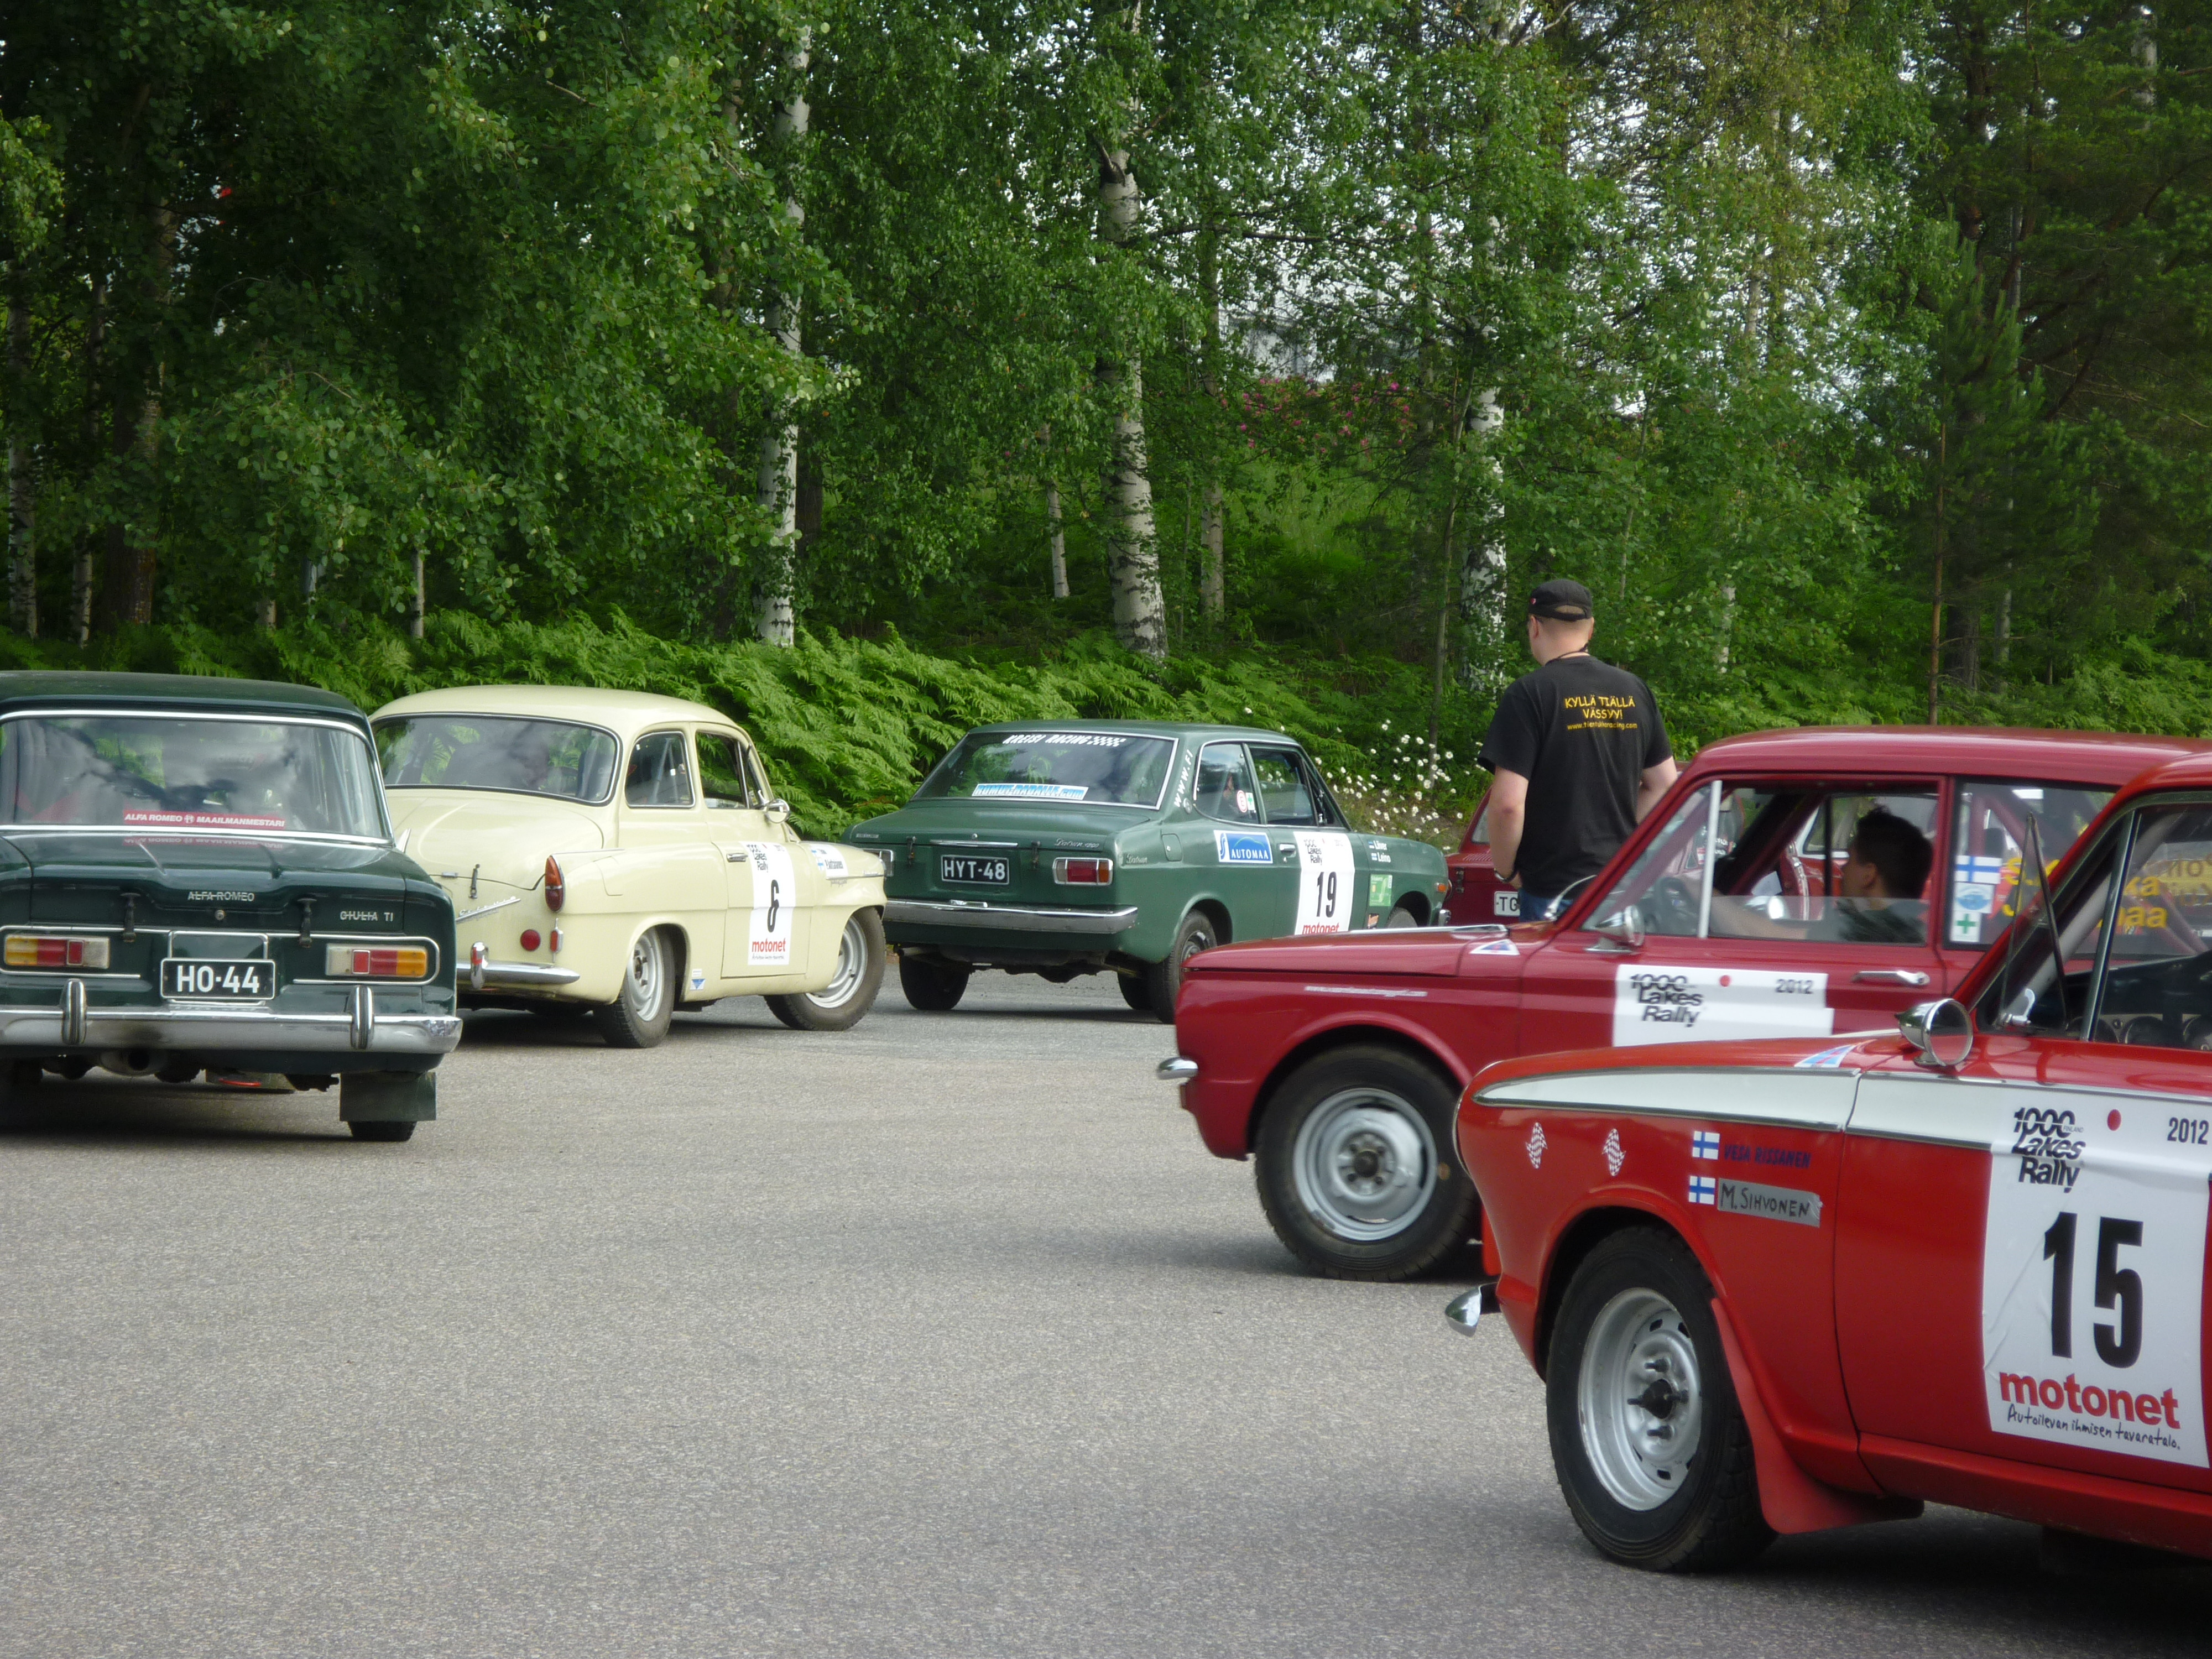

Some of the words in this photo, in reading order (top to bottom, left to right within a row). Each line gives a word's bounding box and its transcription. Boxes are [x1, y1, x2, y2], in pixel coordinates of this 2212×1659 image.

[1564, 694, 1597, 708] KYLLÄ
[1598, 695, 1636, 708] TIÄLLÄ
[1045, 734, 1092, 745] RACING
[148, 814, 183, 822] ROMEO
[196, 816, 285, 827] MAAILMANMESTARI
[1054, 838, 1083, 847] Datsun
[1231, 848, 1269, 860] AUTOMAA
[943, 860, 1005, 880] HYT-48
[1316, 871, 1337, 918] 19
[340, 911, 378, 921] GIULIA
[383, 912, 393, 922] TI
[767, 879, 780, 933] 6
[1302, 922, 1339, 935] motonet
[752, 937, 786, 953] motonet
[1630, 973, 1688, 992] 1000
[1775, 978, 1815, 995] 2012
[1637, 988, 1705, 1007] Lakes
[1641, 1005, 1702, 1028] Rally
[2013, 1107, 2075, 1139] 1000
[2167, 1117, 2210, 1145] 2012
[1724, 1144, 1751, 1162] VESA
[1754, 1146, 1812, 1169] RISSANEN
[2011, 1134, 2086, 1160] Lakes
[2018, 1156, 2081, 1194] Rally
[1720, 1182, 1738, 1210] M.
[2043, 1211, 2144, 1369] 15
[1999, 1371, 2181, 1430] motonet
[2007, 1403, 2068, 1431] Autoilevan
[2071, 1416, 2112, 1438] ihmisen
[2115, 1422, 2180, 1450] tavaratalo.
